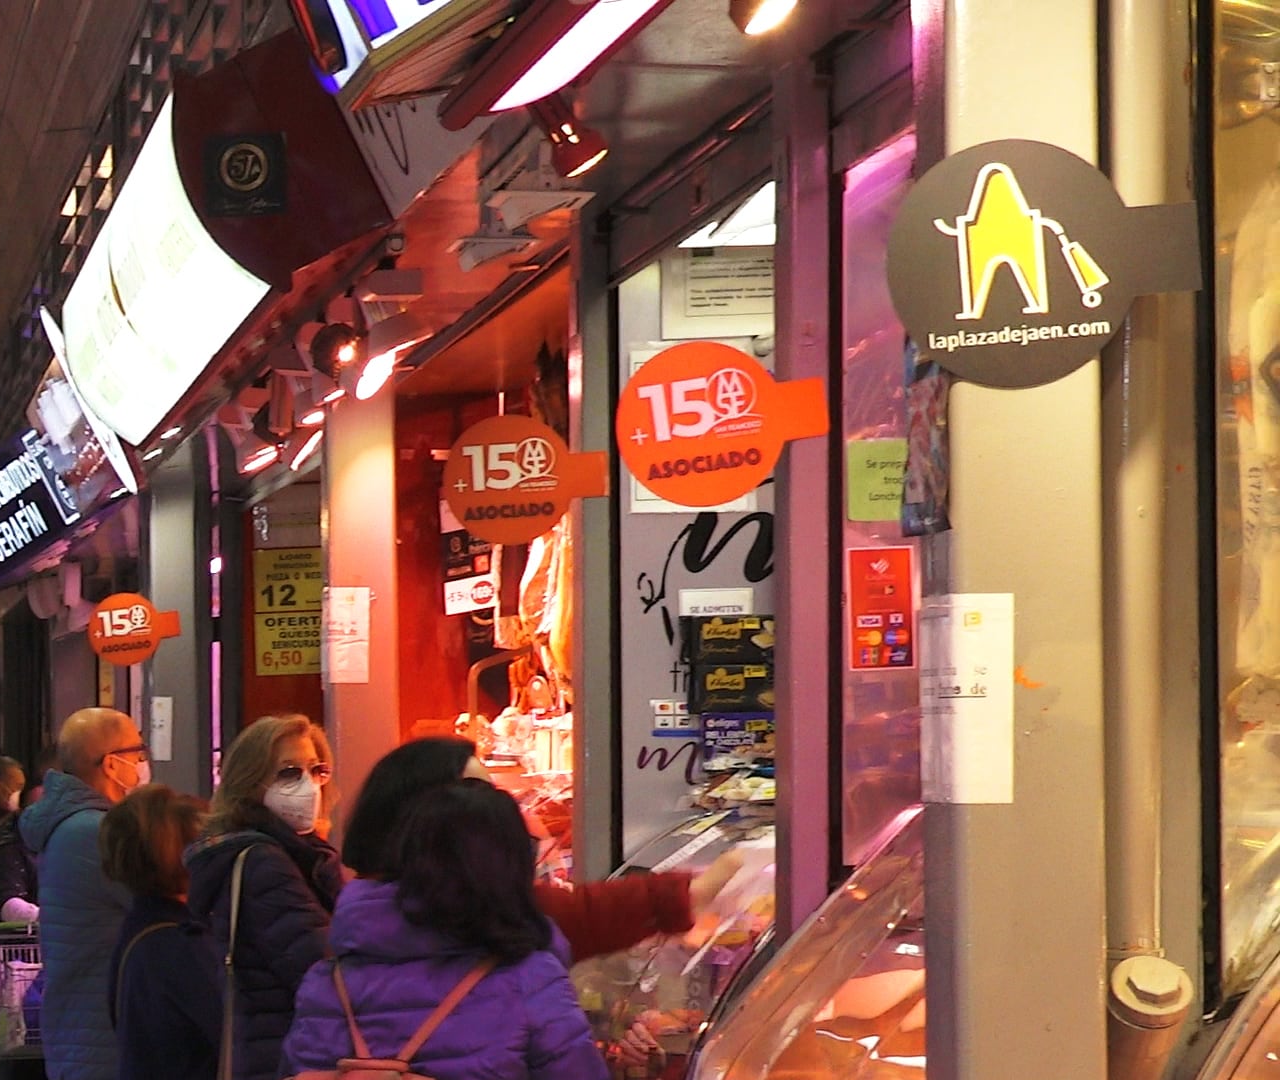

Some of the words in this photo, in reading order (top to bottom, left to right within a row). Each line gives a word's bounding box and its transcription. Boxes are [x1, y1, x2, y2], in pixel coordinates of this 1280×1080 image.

[928, 321, 1111, 352] laplazadejaen.com
[647, 447, 763, 481] ASOCIADO
[865, 459, 878, 469] Se
[464, 501, 555, 521] ASOCIADO
[261, 584, 297, 608] 12
[690, 605, 702, 614] SE
[703, 604, 744, 614] ADMITEN
[279, 630, 320, 639] QUESO
[272, 640, 321, 650] SEMICURAD
[262, 650, 303, 670] 6,50
[970, 682, 988, 695] de
